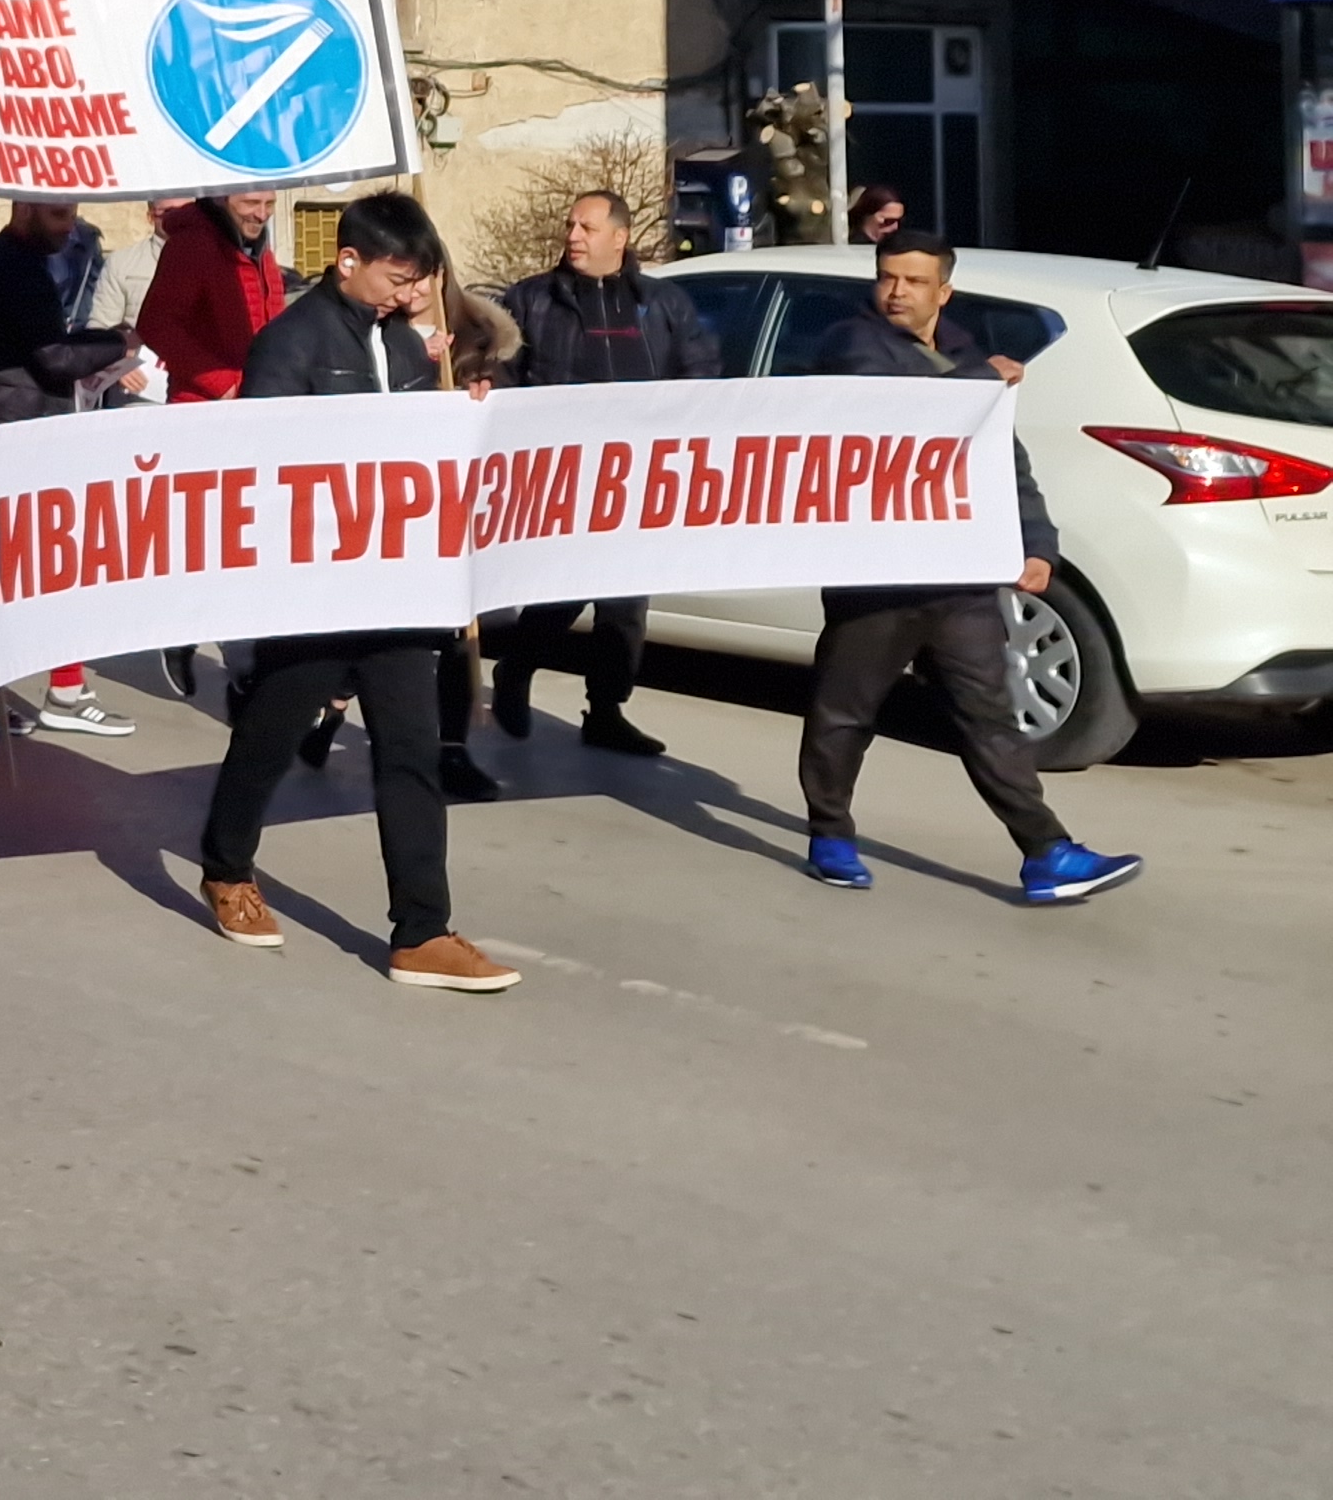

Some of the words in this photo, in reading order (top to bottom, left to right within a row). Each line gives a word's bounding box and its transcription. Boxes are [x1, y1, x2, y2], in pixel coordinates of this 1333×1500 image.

[0, 91, 137, 138] ИМАМЕ
[277, 443, 582, 565] ТУРИЗМА
[587, 441, 633, 533] В
[639, 434, 974, 529] БЪЛГАРИЯ!
